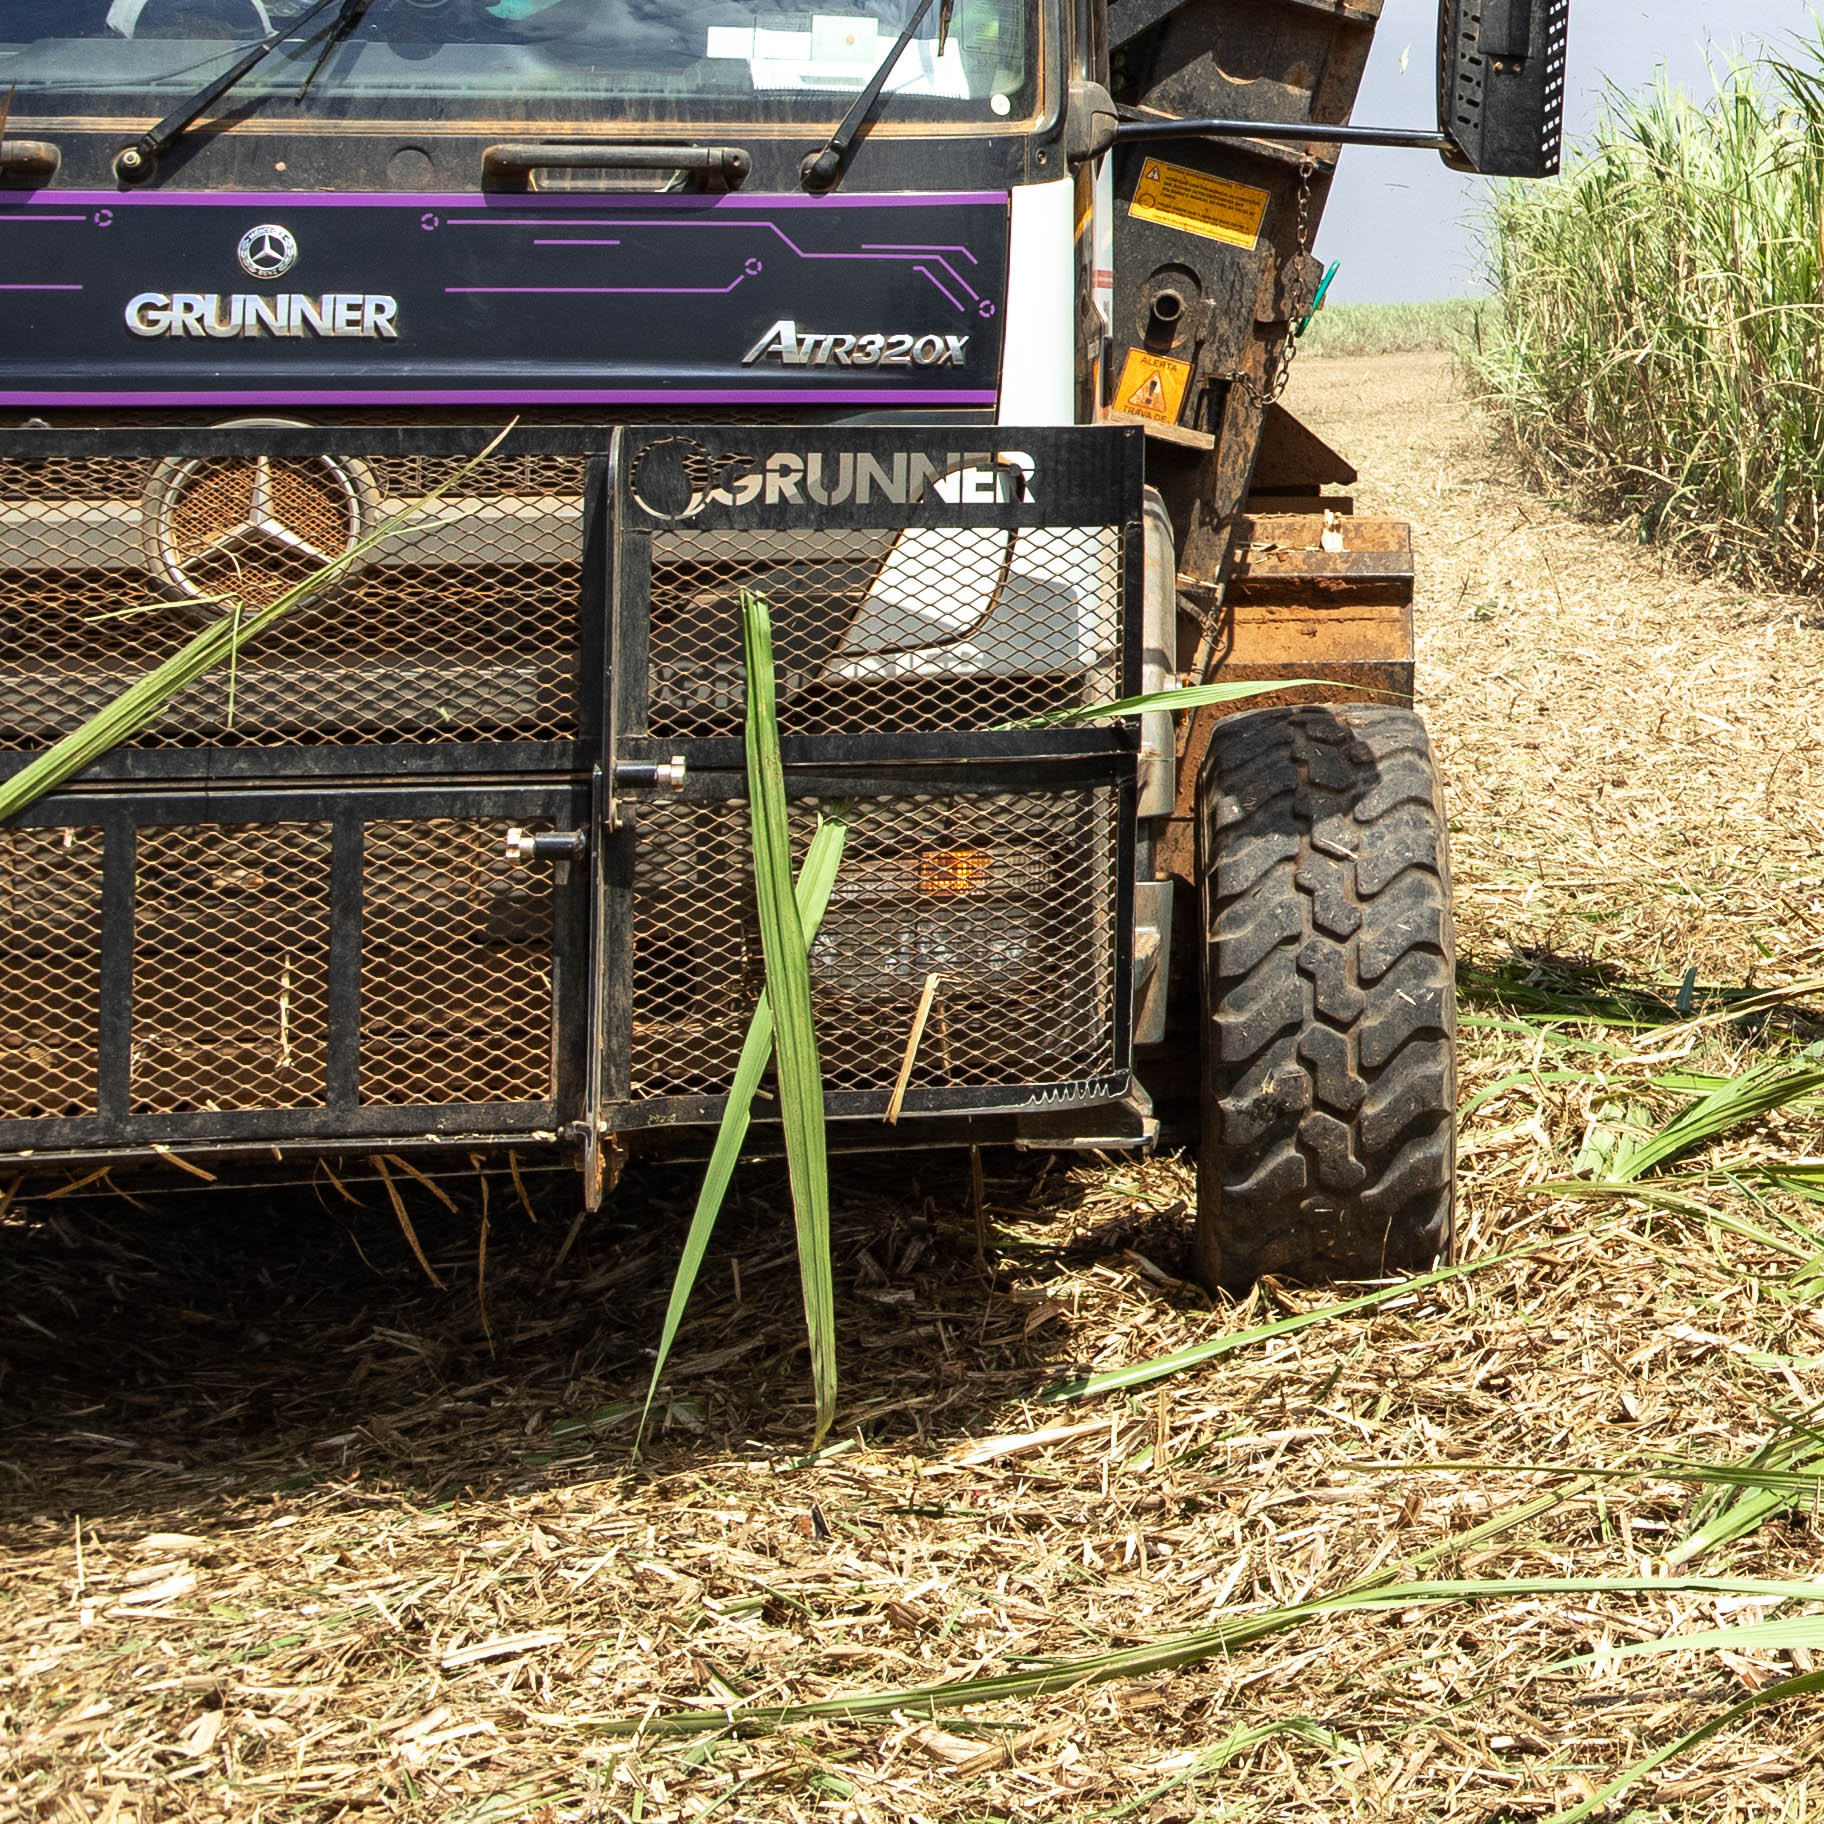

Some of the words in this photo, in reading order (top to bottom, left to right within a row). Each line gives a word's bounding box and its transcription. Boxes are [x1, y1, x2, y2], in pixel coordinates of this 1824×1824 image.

[124, 291, 399, 339] GRUNNER
[741, 319, 970, 367] ATR320X
[1140, 356, 1178, 373] ALERTA
[1123, 405, 1152, 420] TRAVA
[708, 450, 1037, 506] GRUNNER
